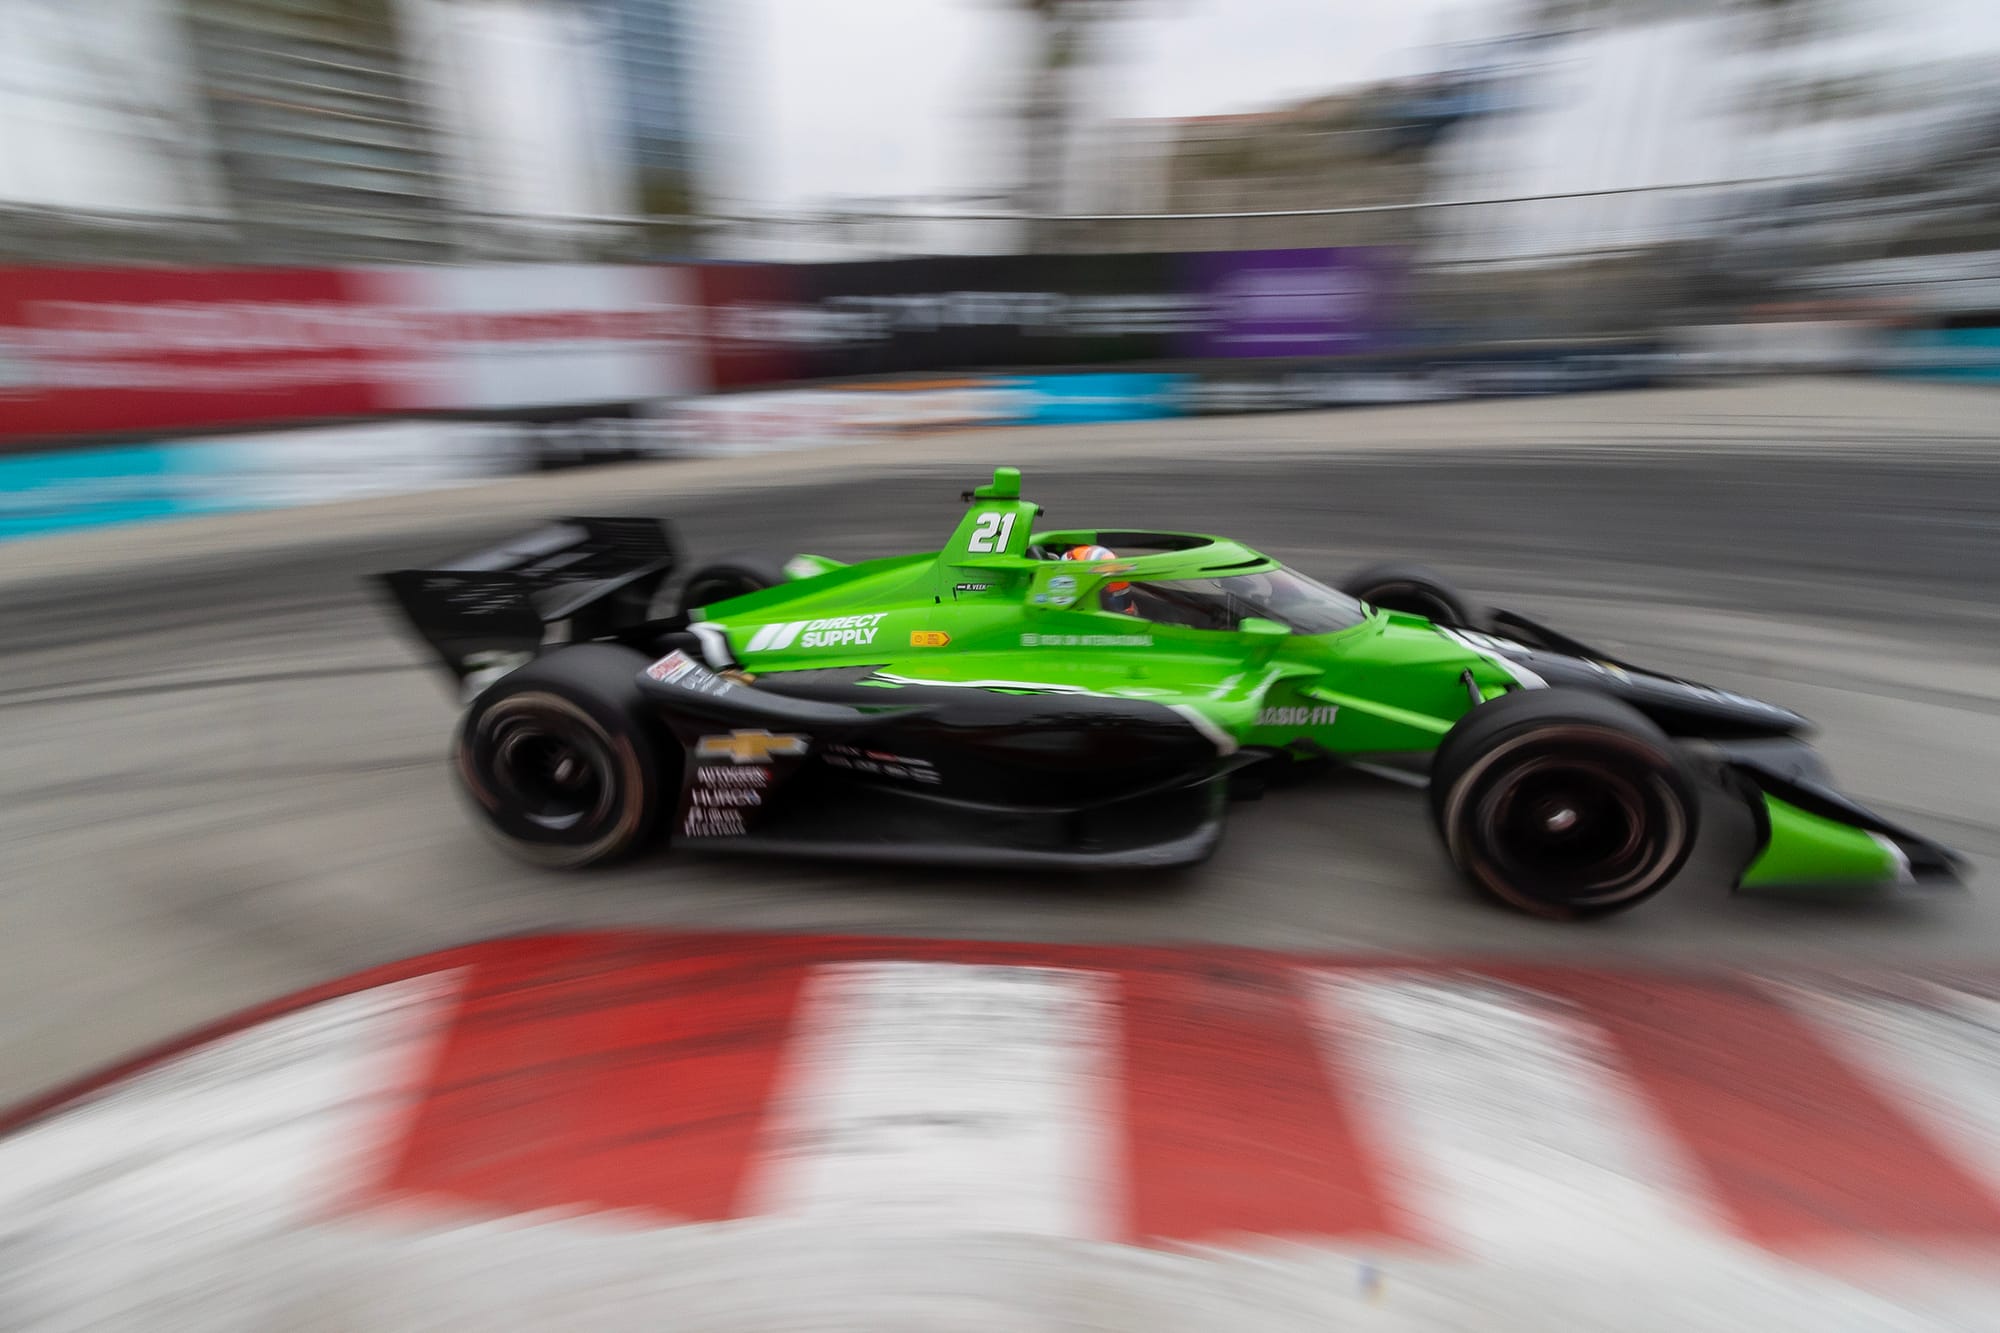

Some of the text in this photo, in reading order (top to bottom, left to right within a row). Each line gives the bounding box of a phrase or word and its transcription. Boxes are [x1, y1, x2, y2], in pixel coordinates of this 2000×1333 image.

[968, 512, 1016, 553] 21
[806, 613, 888, 632] DIRECT
[801, 628, 878, 647] SUPPLY
